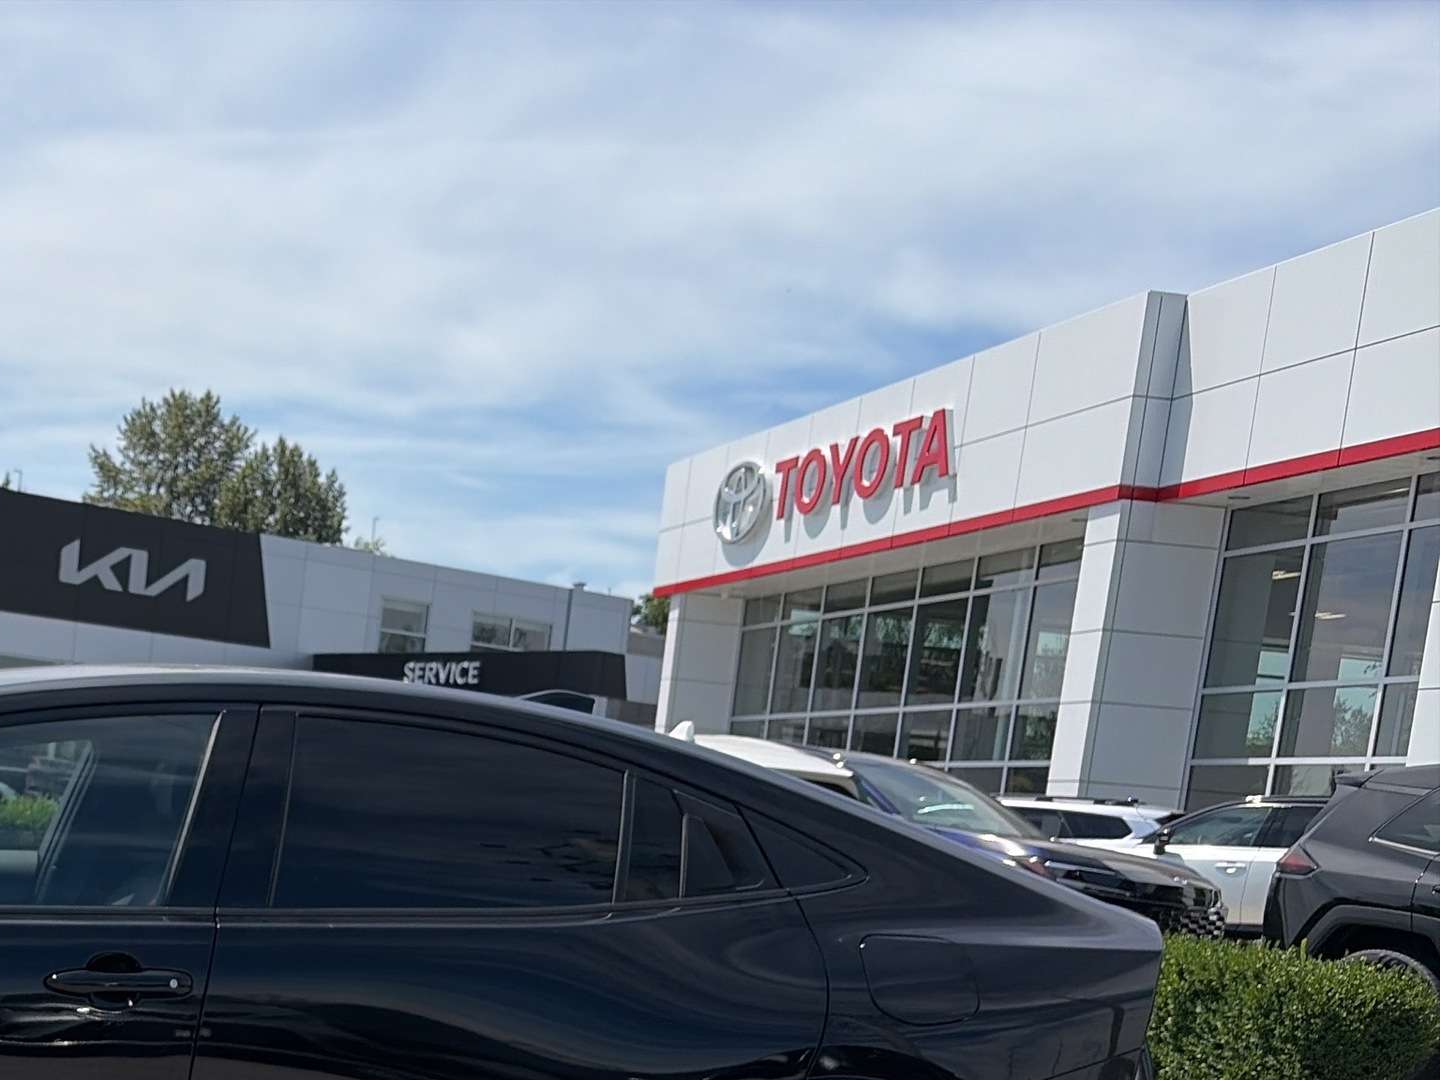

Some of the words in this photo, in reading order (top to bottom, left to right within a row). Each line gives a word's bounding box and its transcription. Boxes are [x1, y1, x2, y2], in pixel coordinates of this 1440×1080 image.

[775, 408, 950, 521] TOYOTA
[59, 538, 207, 602] KIA
[403, 660, 481, 685] SERVICE
